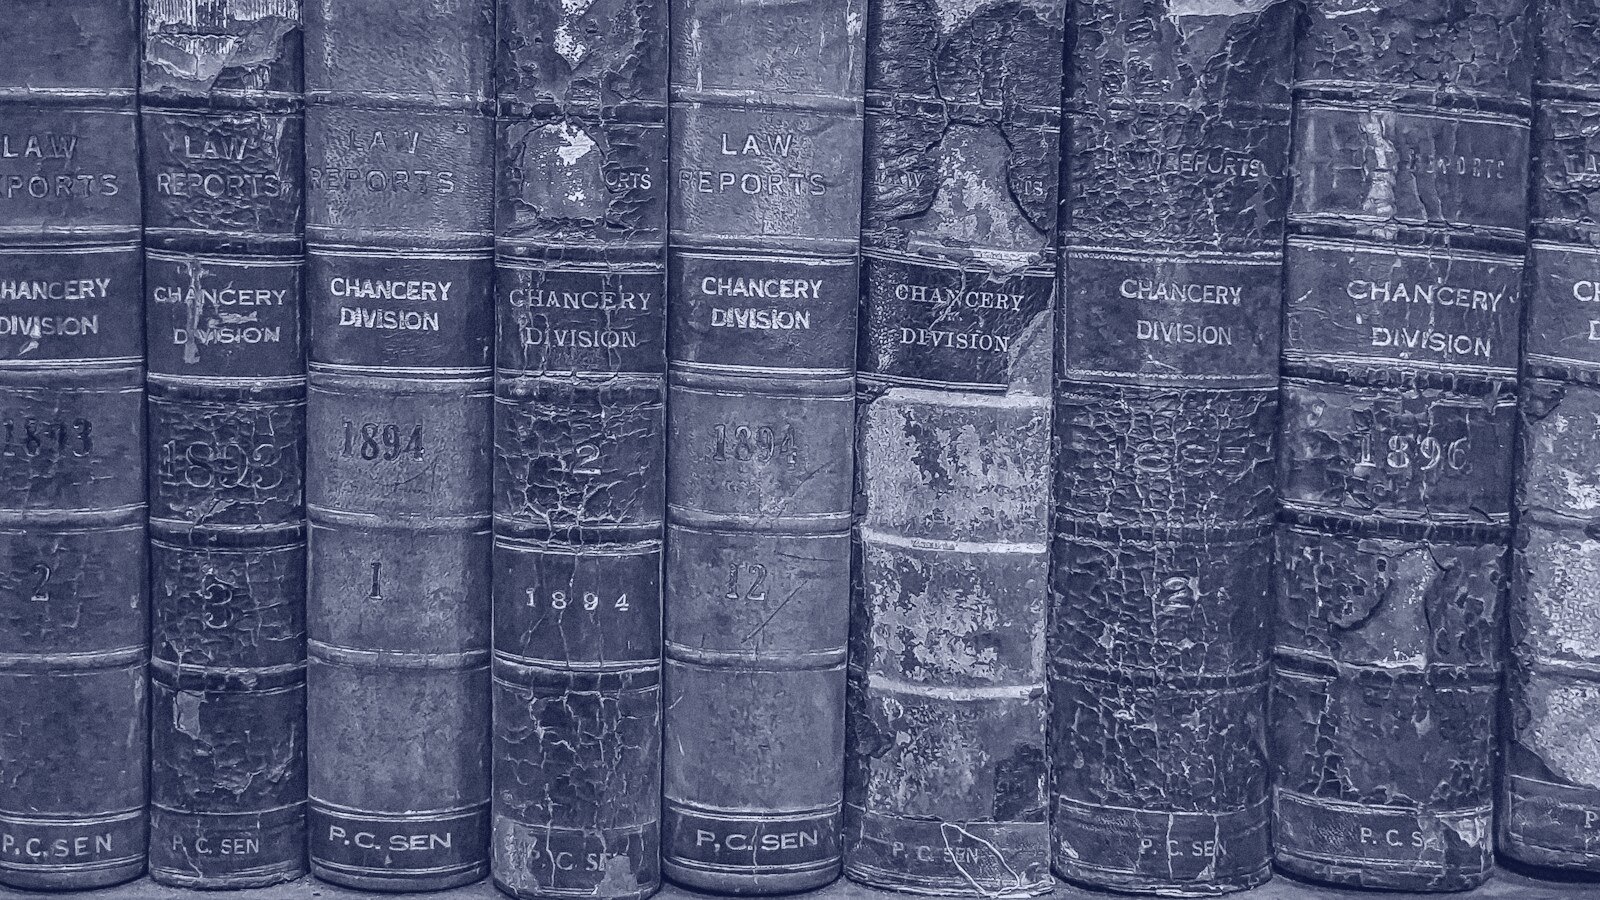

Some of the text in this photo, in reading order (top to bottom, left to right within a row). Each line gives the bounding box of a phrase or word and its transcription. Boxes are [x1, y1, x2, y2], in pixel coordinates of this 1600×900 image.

[3, 134, 77, 160] LAW
[184, 135, 248, 160] LAW
[720, 134, 794, 157] LAW
[0, 173, 119, 198] PORTS
[157, 172, 281, 198] REPORTS
[309, 168, 455, 194] REPORTS
[679, 169, 827, 196] REPORTS
[0, 278, 110, 300] HANCERY
[153, 286, 287, 306] CHANCERY
[330, 277, 452, 301] CHANCERY
[509, 288, 652, 311] CHANCERY
[701, 276, 823, 299] CHANCERY
[894, 284, 1026, 312] CHANCERY
[1119, 279, 1243, 306] CHANCERY
[1346, 280, 1507, 312] CHANCERY
[0, 315, 99, 338] DIVISION
[339, 306, 440, 331] DIVISION
[710, 307, 811, 330] DIVISION
[173, 326, 281, 346] DIVISION
[525, 327, 637, 348] DIVISION
[900, 327, 1011, 353] DIVISION
[1136, 319, 1233, 345] DIVISION
[1371, 326, 1491, 357] DIVISION
[341, 420, 425, 462] 1894
[712, 423, 799, 467] 1894
[1353, 431, 1474, 473] 1896
[572, 443, 602, 475] 2
[30, 564, 50, 601] 2
[368, 562, 383, 600] 1
[1162, 576, 1194, 609] 2
[220, 838, 260, 855] SEN
[389, 831, 453, 851] SEN
[761, 829, 819, 850] SEN
[1191, 840, 1228, 858] SEN
